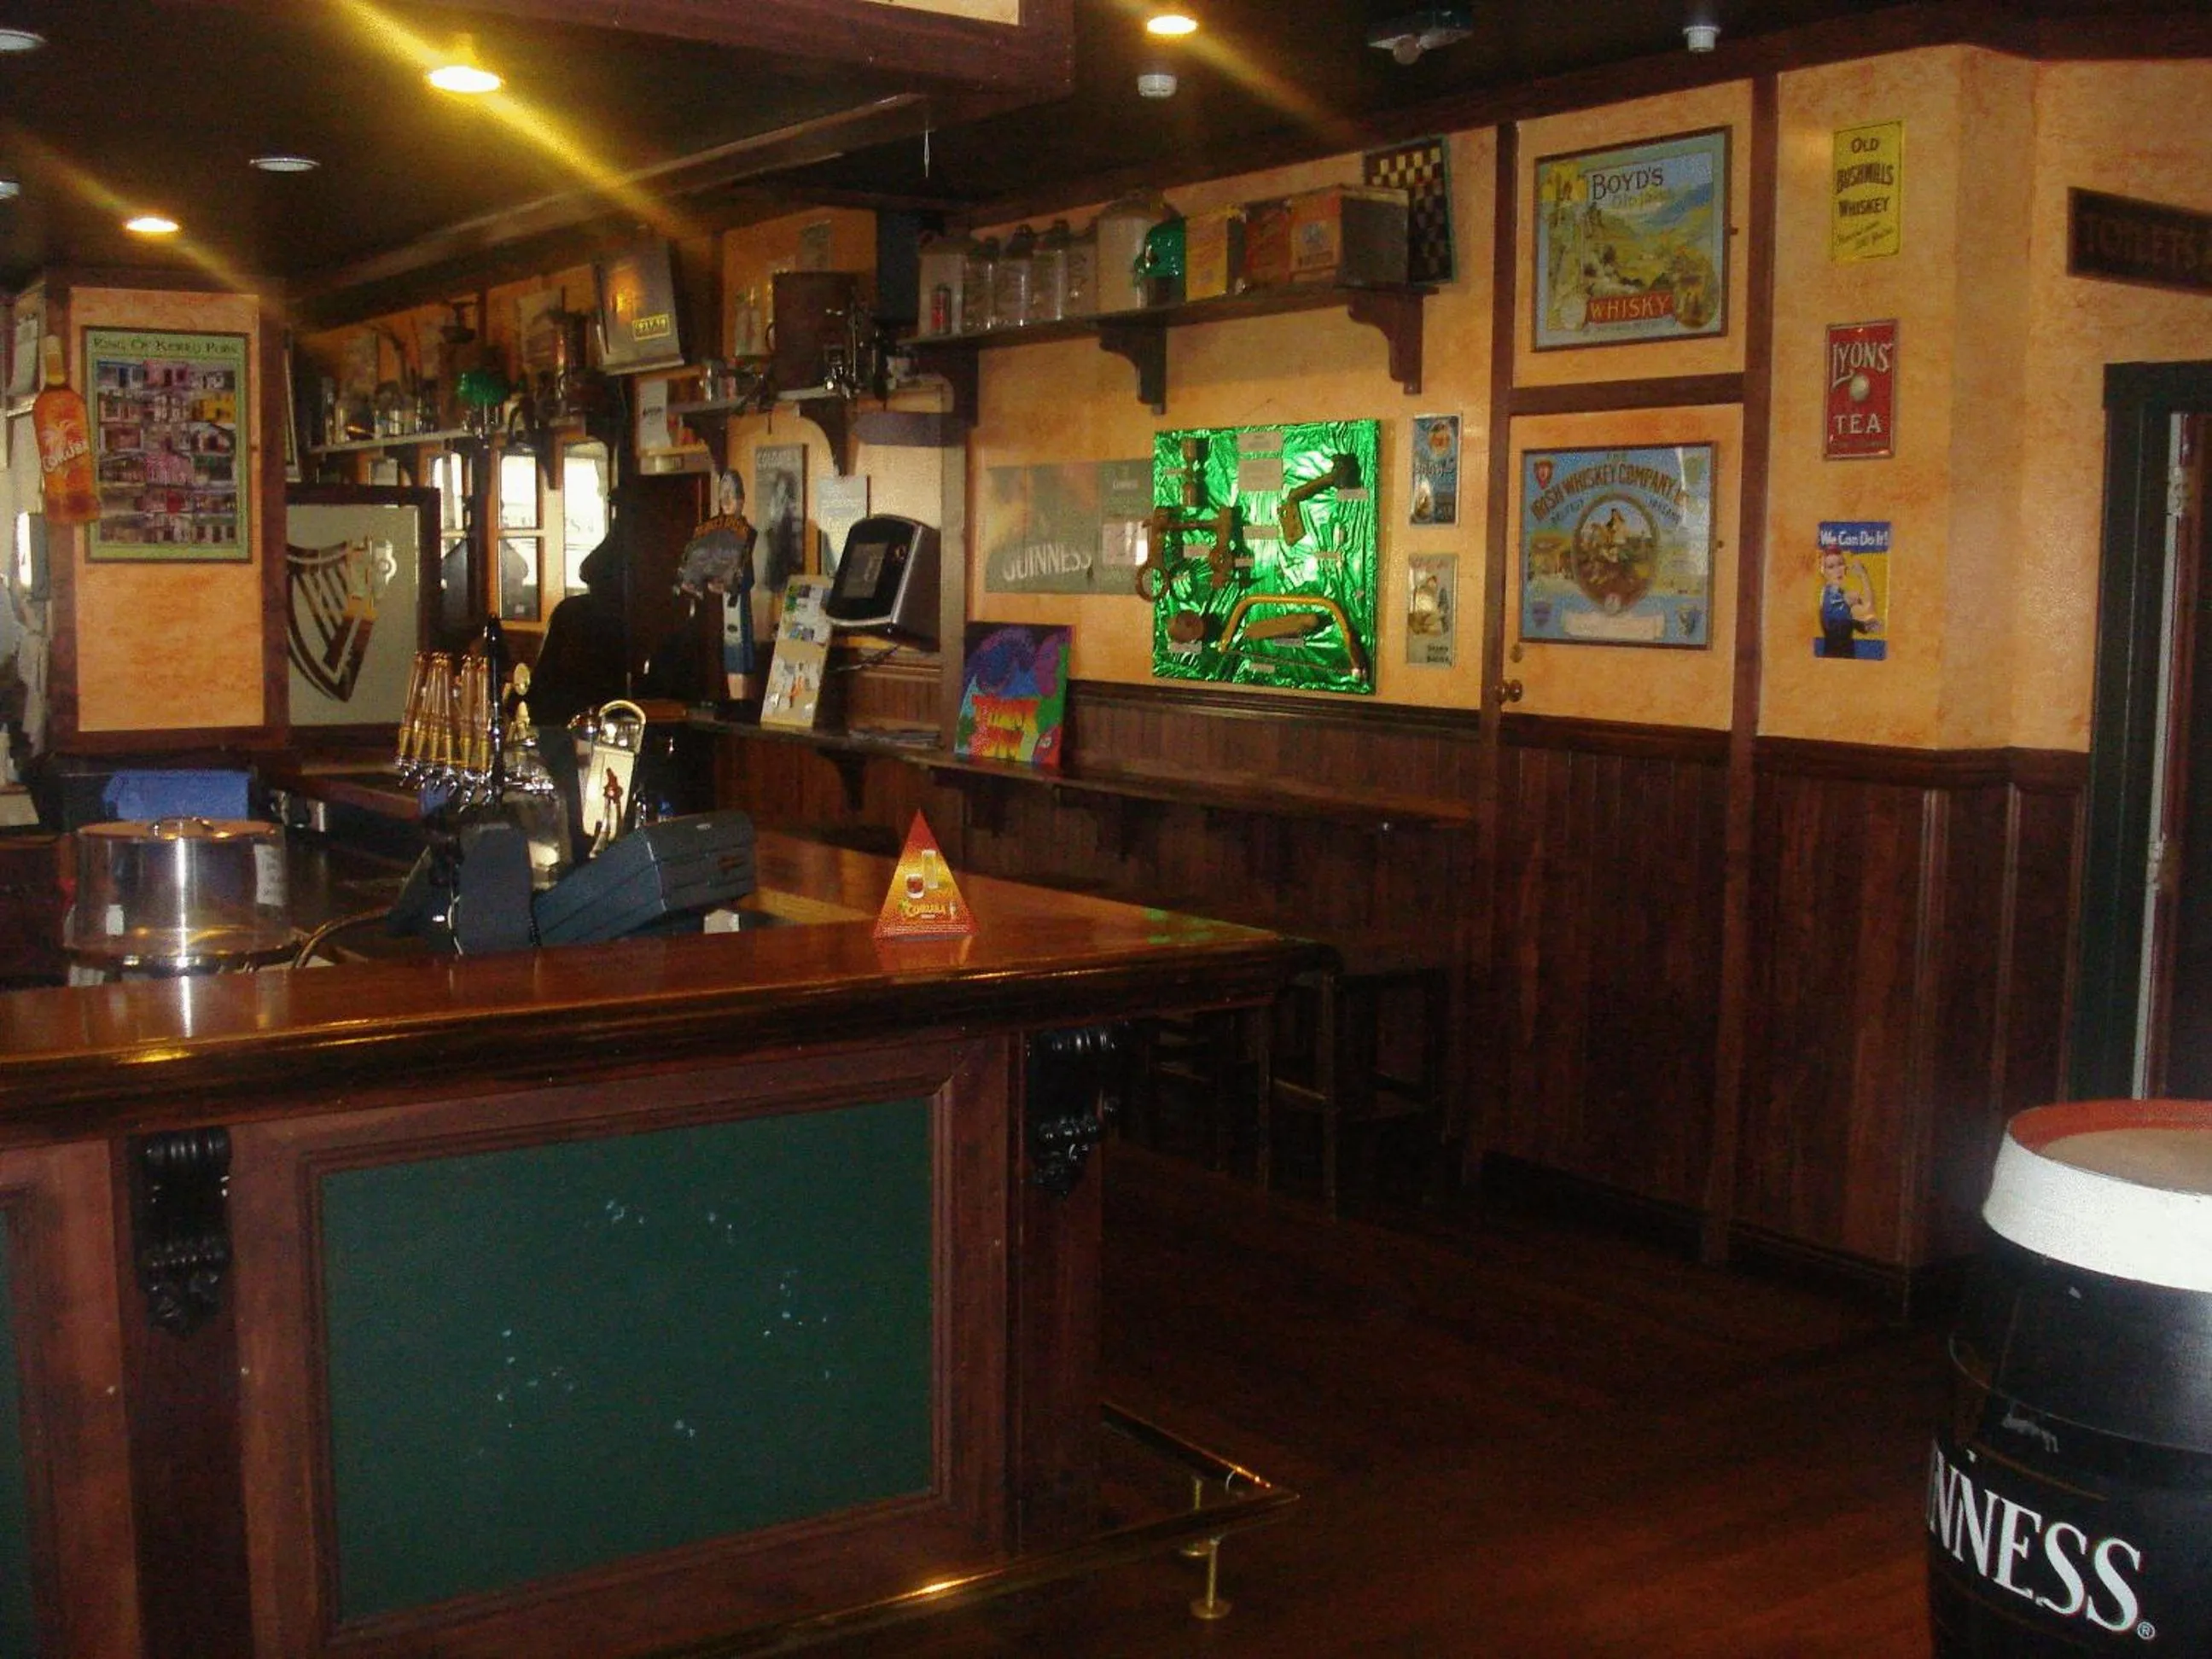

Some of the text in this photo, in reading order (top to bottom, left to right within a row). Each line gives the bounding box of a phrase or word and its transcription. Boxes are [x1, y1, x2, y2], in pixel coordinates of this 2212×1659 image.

[1850, 137, 1881, 154] OLD
[1592, 166, 1663, 201] BOYD'S
[1838, 196, 1890, 218] WHISKEY
[1590, 294, 1670, 319] WHISKY
[1833, 413, 1883, 434] TEA
[1820, 530, 1837, 546] We
[1838, 530, 1859, 547] Can
[1860, 530, 1875, 546] Do
